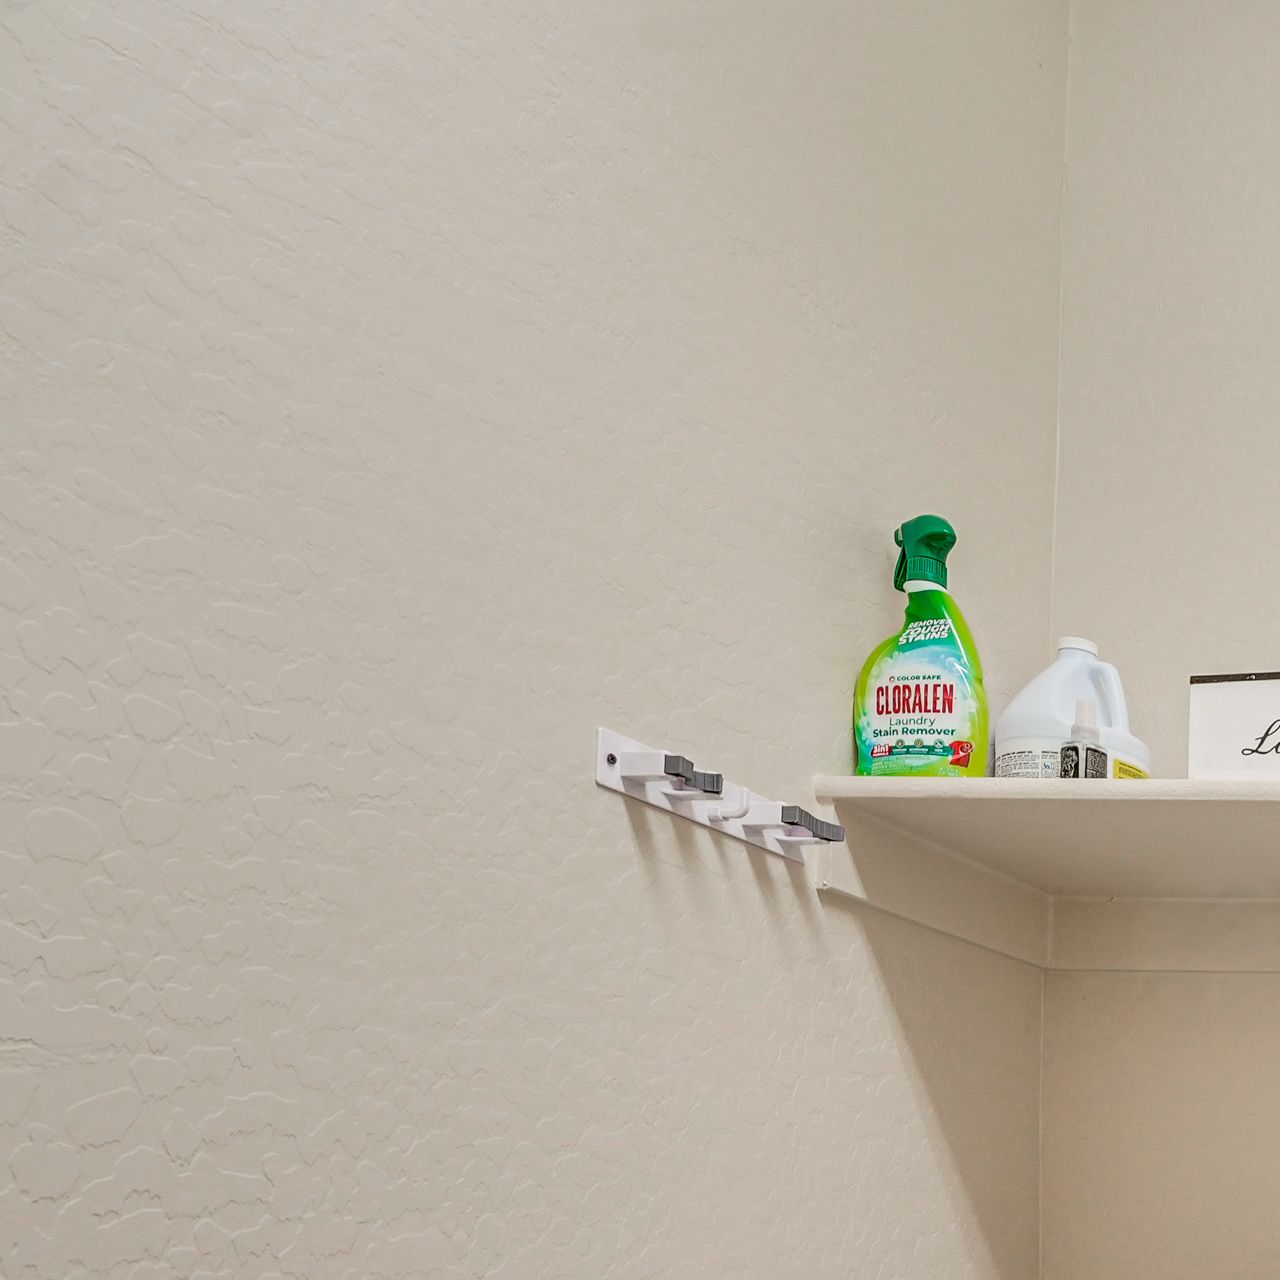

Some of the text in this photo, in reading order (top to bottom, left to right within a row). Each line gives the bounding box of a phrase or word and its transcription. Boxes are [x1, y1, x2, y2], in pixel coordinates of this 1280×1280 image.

[902, 625, 950, 636] TOUGH
[898, 631, 949, 645] STAINS
[876, 684, 954, 716] CLORALEN
[889, 716, 936, 728] Laundry
[872, 727, 956, 738] Stain Remover
